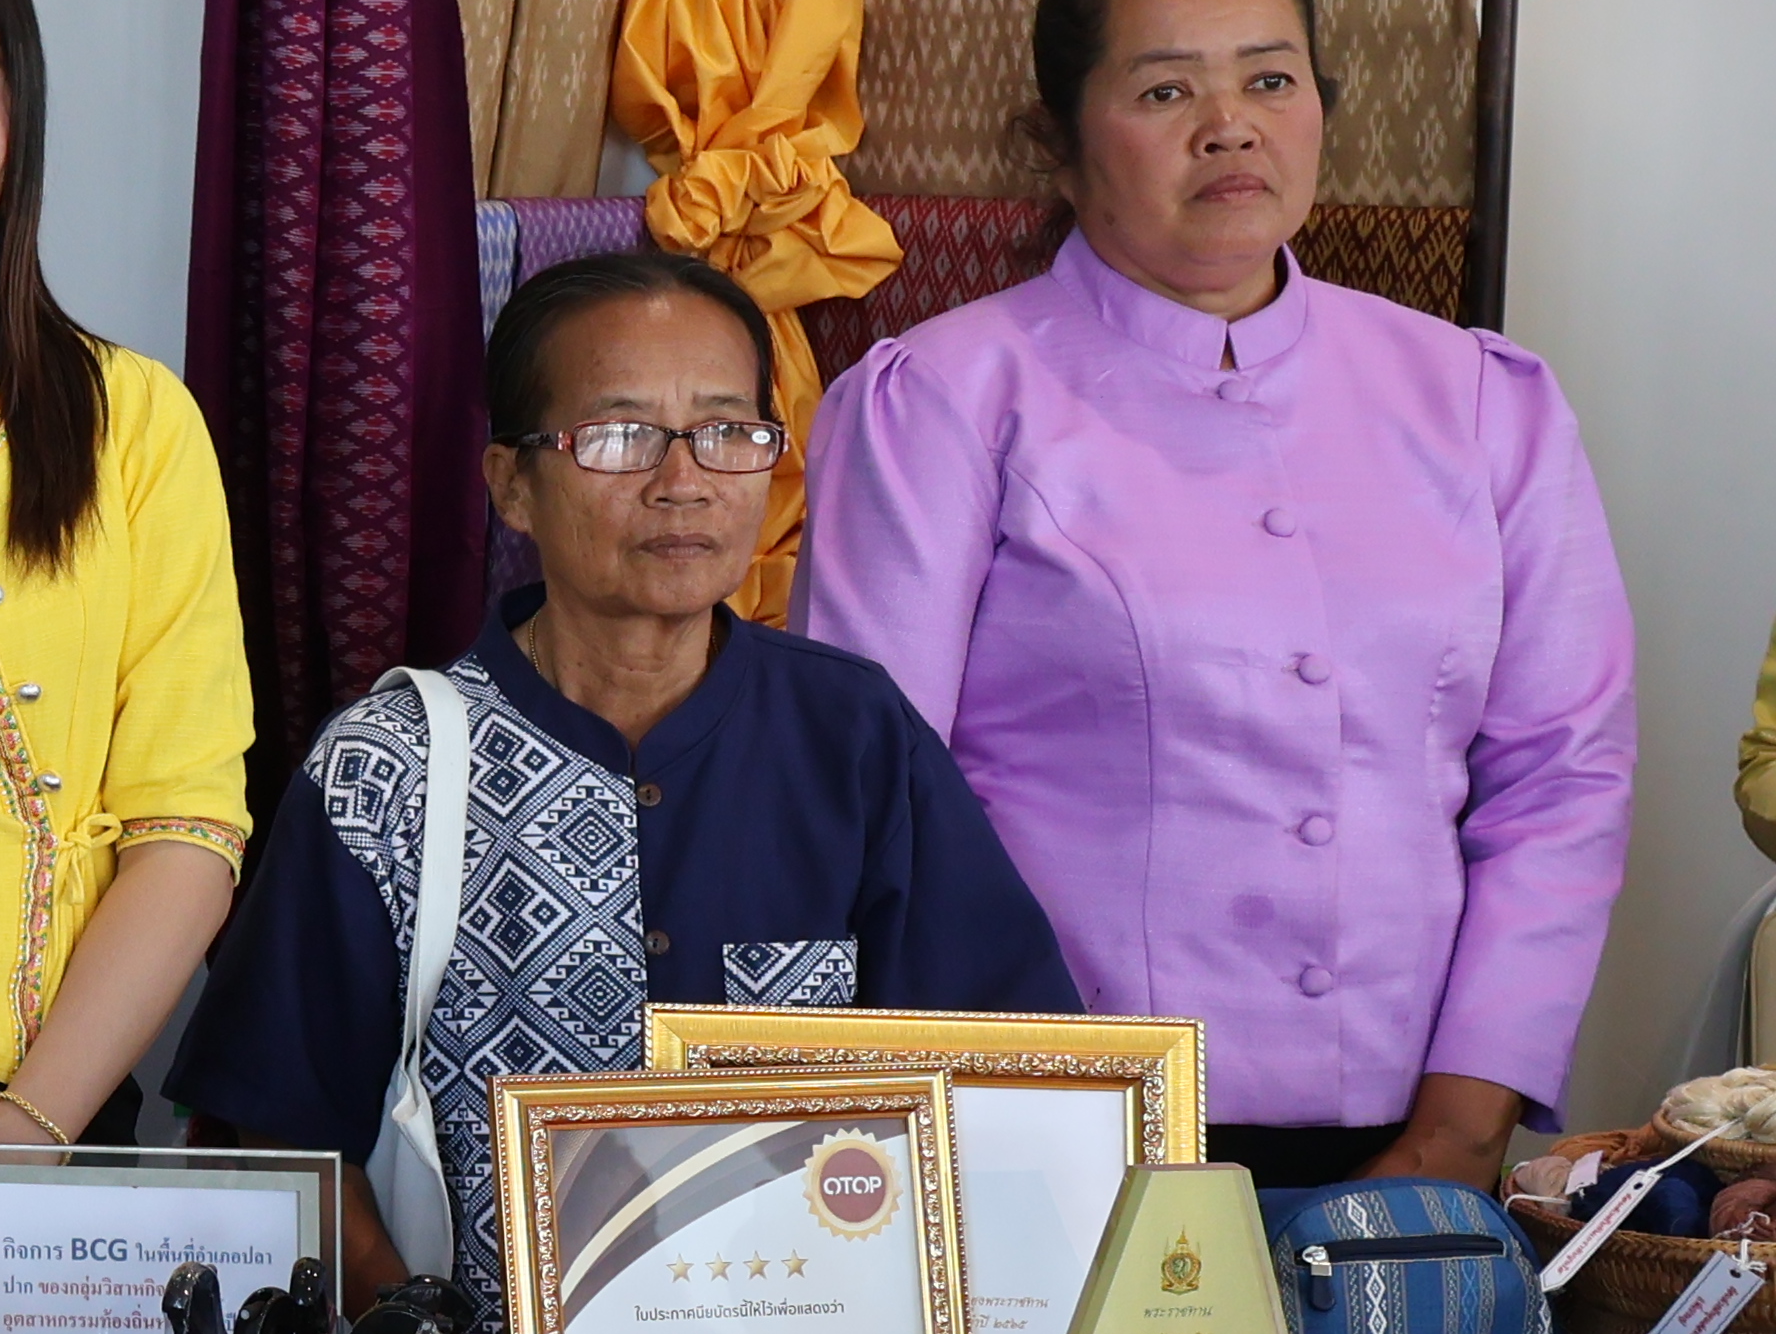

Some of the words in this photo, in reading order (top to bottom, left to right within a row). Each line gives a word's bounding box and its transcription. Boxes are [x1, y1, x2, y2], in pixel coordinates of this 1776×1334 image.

[821, 1176, 884, 1196] OTOP
[3, 1237, 63, 1260] กิจการ
[71, 1238, 128, 1262] BCG
[136, 1237, 273, 1264] ในพื้นที่อำเภอปลา
[3, 1277, 33, 1294] ปาก
[38, 1276, 164, 1300] ของกลุ่มวิสาหกิจ
[3, 1304, 164, 1332] อุตสาหกรรมท้องถิ่นห
[635, 1298, 844, 1321] ใบประกาศนียบัตรนี้ให้ไว้เพื่อแสดงว่า
[1143, 1305, 1213, 1318] พระราชทาน
